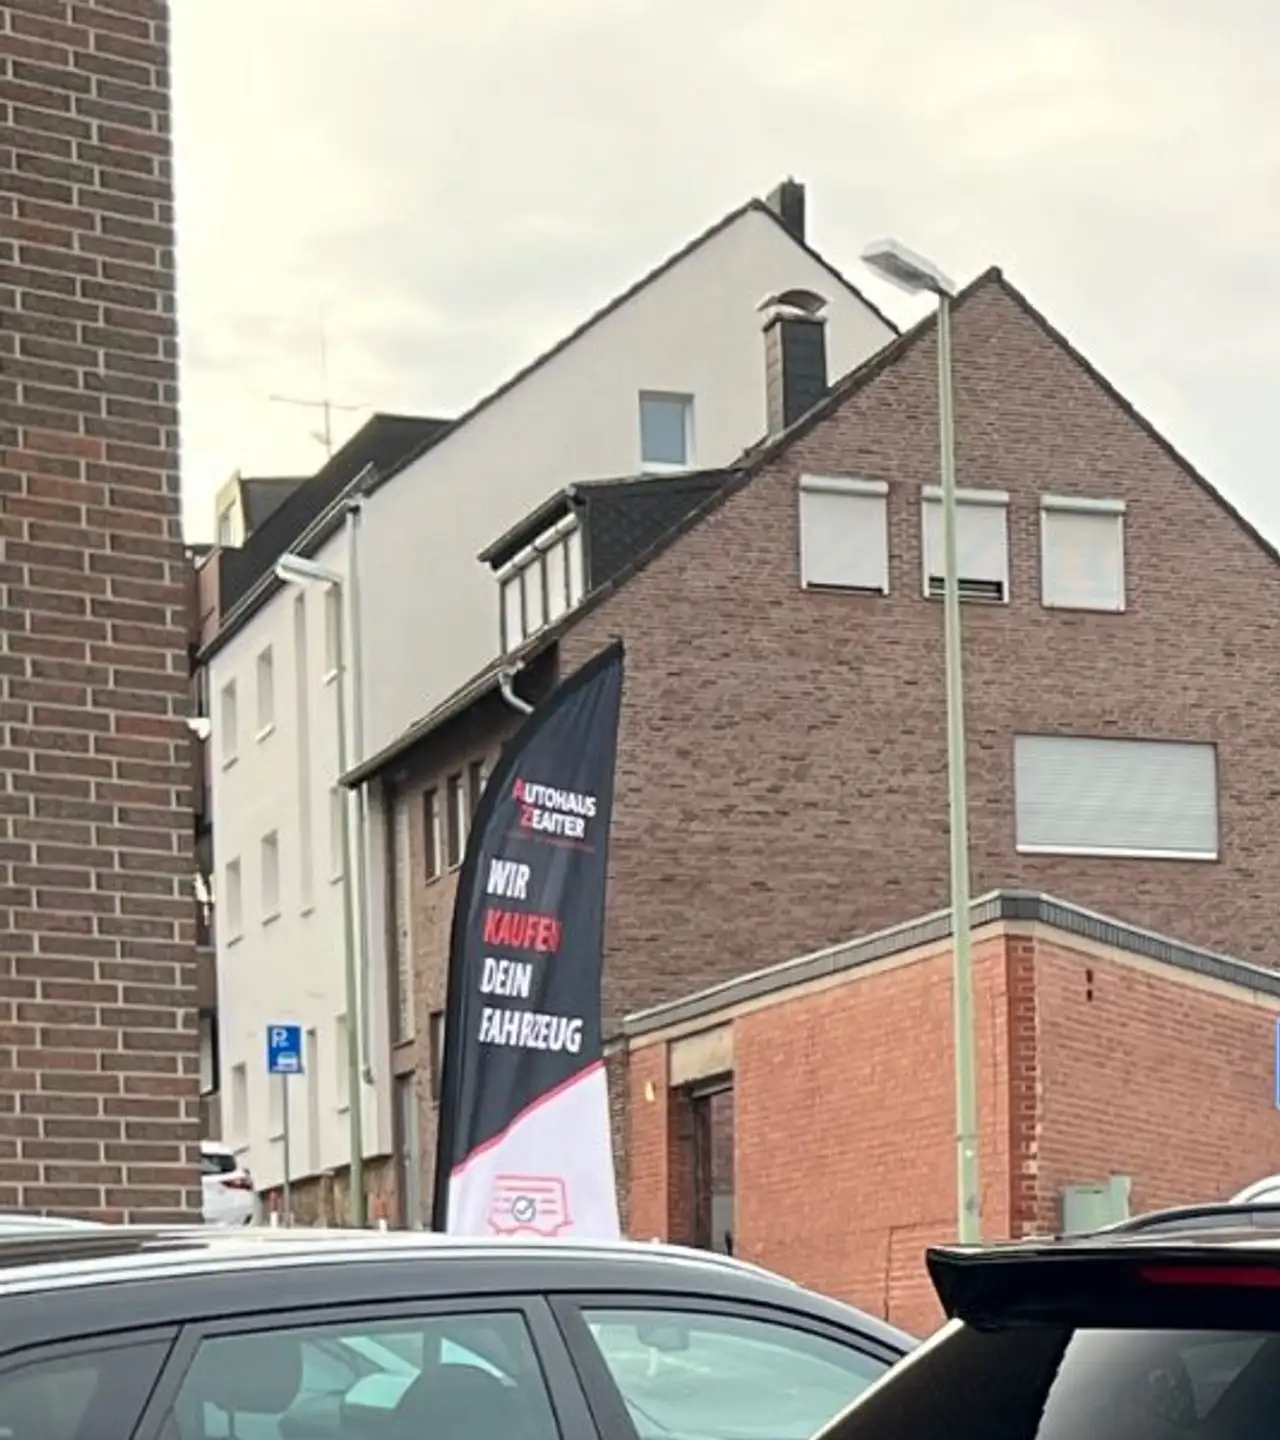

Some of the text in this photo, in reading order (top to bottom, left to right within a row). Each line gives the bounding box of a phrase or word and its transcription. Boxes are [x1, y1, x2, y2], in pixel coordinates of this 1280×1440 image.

[512, 777, 597, 817] AUTOHAUS
[486, 858, 530, 900] WIR
[484, 908, 562, 953] KAUFEN
[480, 957, 533, 999] DEIN
[478, 1007, 583, 1053] FAHRZEUG
